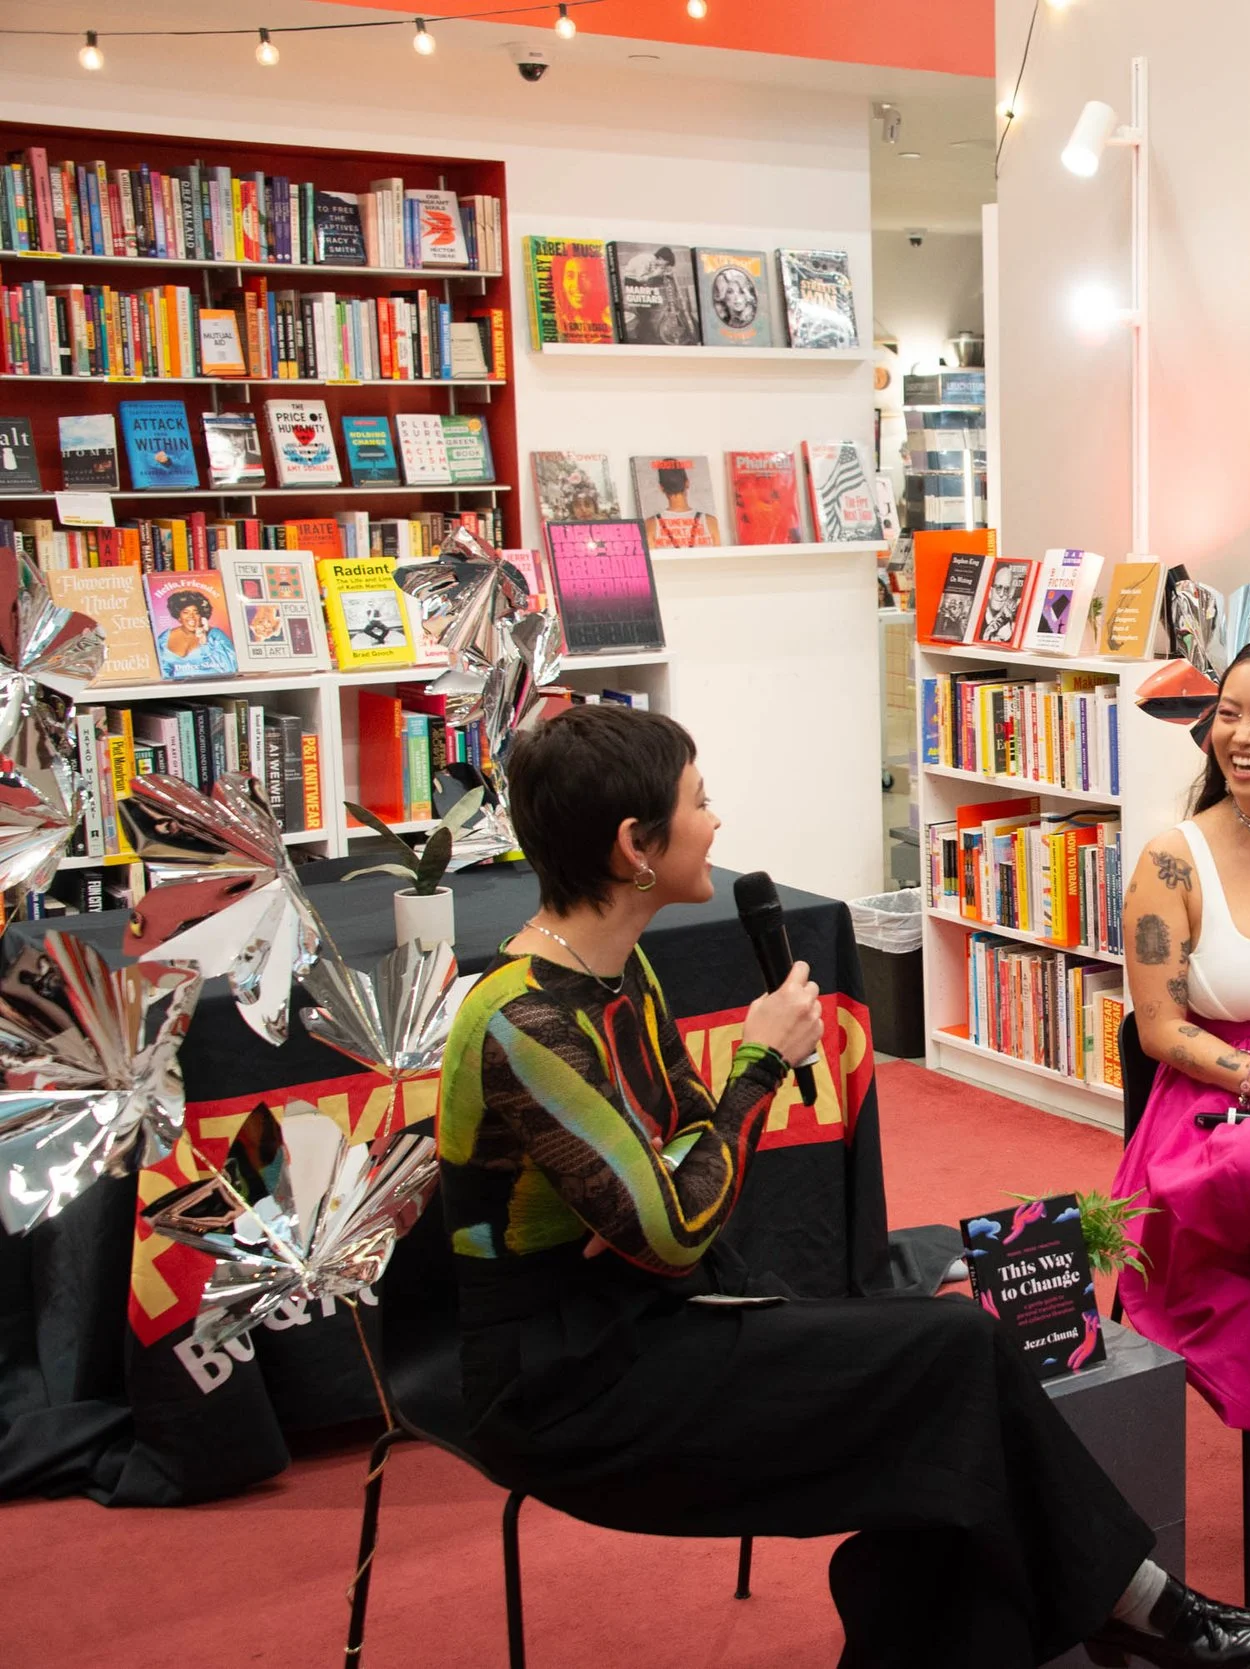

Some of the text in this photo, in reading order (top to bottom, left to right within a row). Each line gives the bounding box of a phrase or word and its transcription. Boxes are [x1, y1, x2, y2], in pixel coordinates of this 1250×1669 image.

[182, 181, 195, 250] DREAMLAND
[203, 332, 234, 340] MUTUAL
[133, 418, 185, 431] ATTACK
[276, 413, 306, 422] PRICE
[0, 427, 30, 447] alt
[135, 438, 190, 451] WITHIN
[333, 563, 390, 577] Radiant
[304, 737, 321, 828] P&T KNITWEAR
[1068, 831, 1078, 896] HOW TO DRAW
[998, 1252, 1075, 1282] This Way
[1001, 1270, 1081, 1302] to Change
[1024, 1327, 1079, 1350] Jezz Chung
